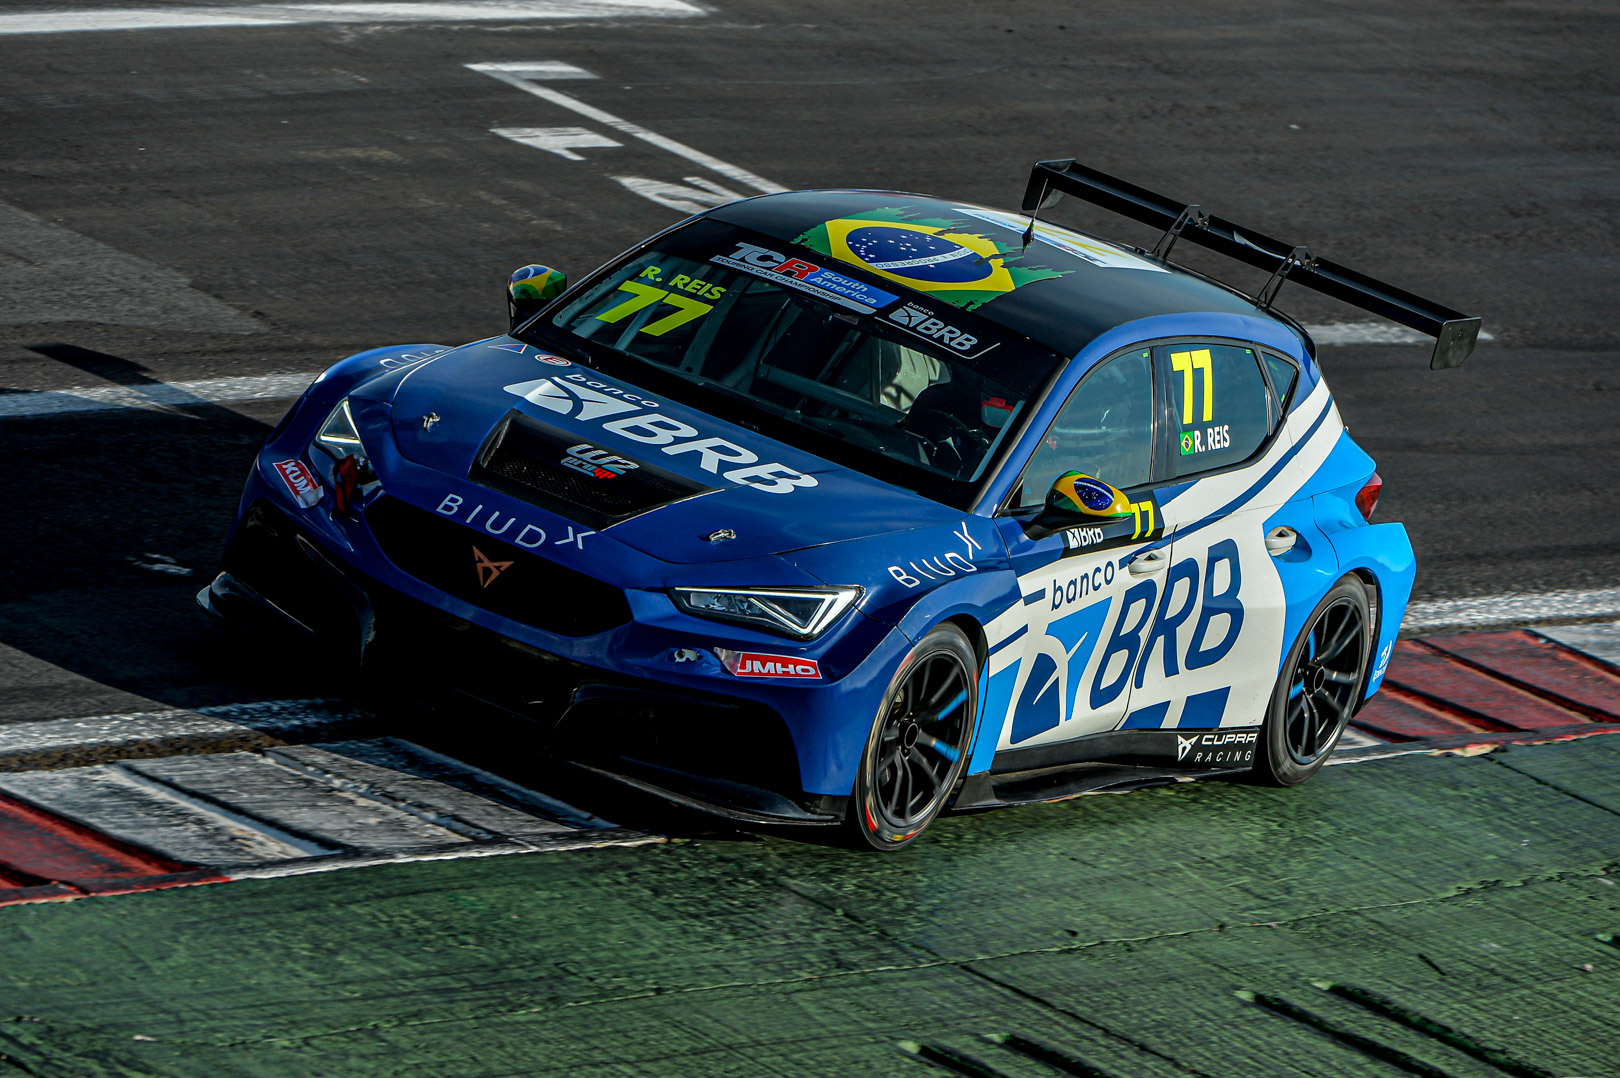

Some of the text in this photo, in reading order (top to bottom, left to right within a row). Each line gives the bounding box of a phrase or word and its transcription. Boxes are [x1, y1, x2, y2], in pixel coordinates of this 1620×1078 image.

[729, 241, 821, 280] TCR
[640, 265, 727, 300] R. REIS
[716, 257, 843, 302] TOURING CAR CHAMPIONSHIP
[809, 276, 878, 305] America
[820, 270, 868, 293] South
[595, 280, 714, 337] 77
[907, 301, 934, 316] banco
[916, 317, 978, 350] BRB
[564, 373, 660, 408] banco
[1170, 348, 1213, 425] 77
[602, 413, 819, 494] BRB
[1193, 424, 1231, 453] R. REIS
[566, 443, 640, 475] W2
[281, 461, 313, 495] KUM
[1130, 500, 1155, 540] 77
[1050, 560, 1115, 612] banco
[1089, 538, 1245, 711] BRB
[1194, 750, 1252, 763] RACING
[1201, 733, 1258, 745] CUPRA
